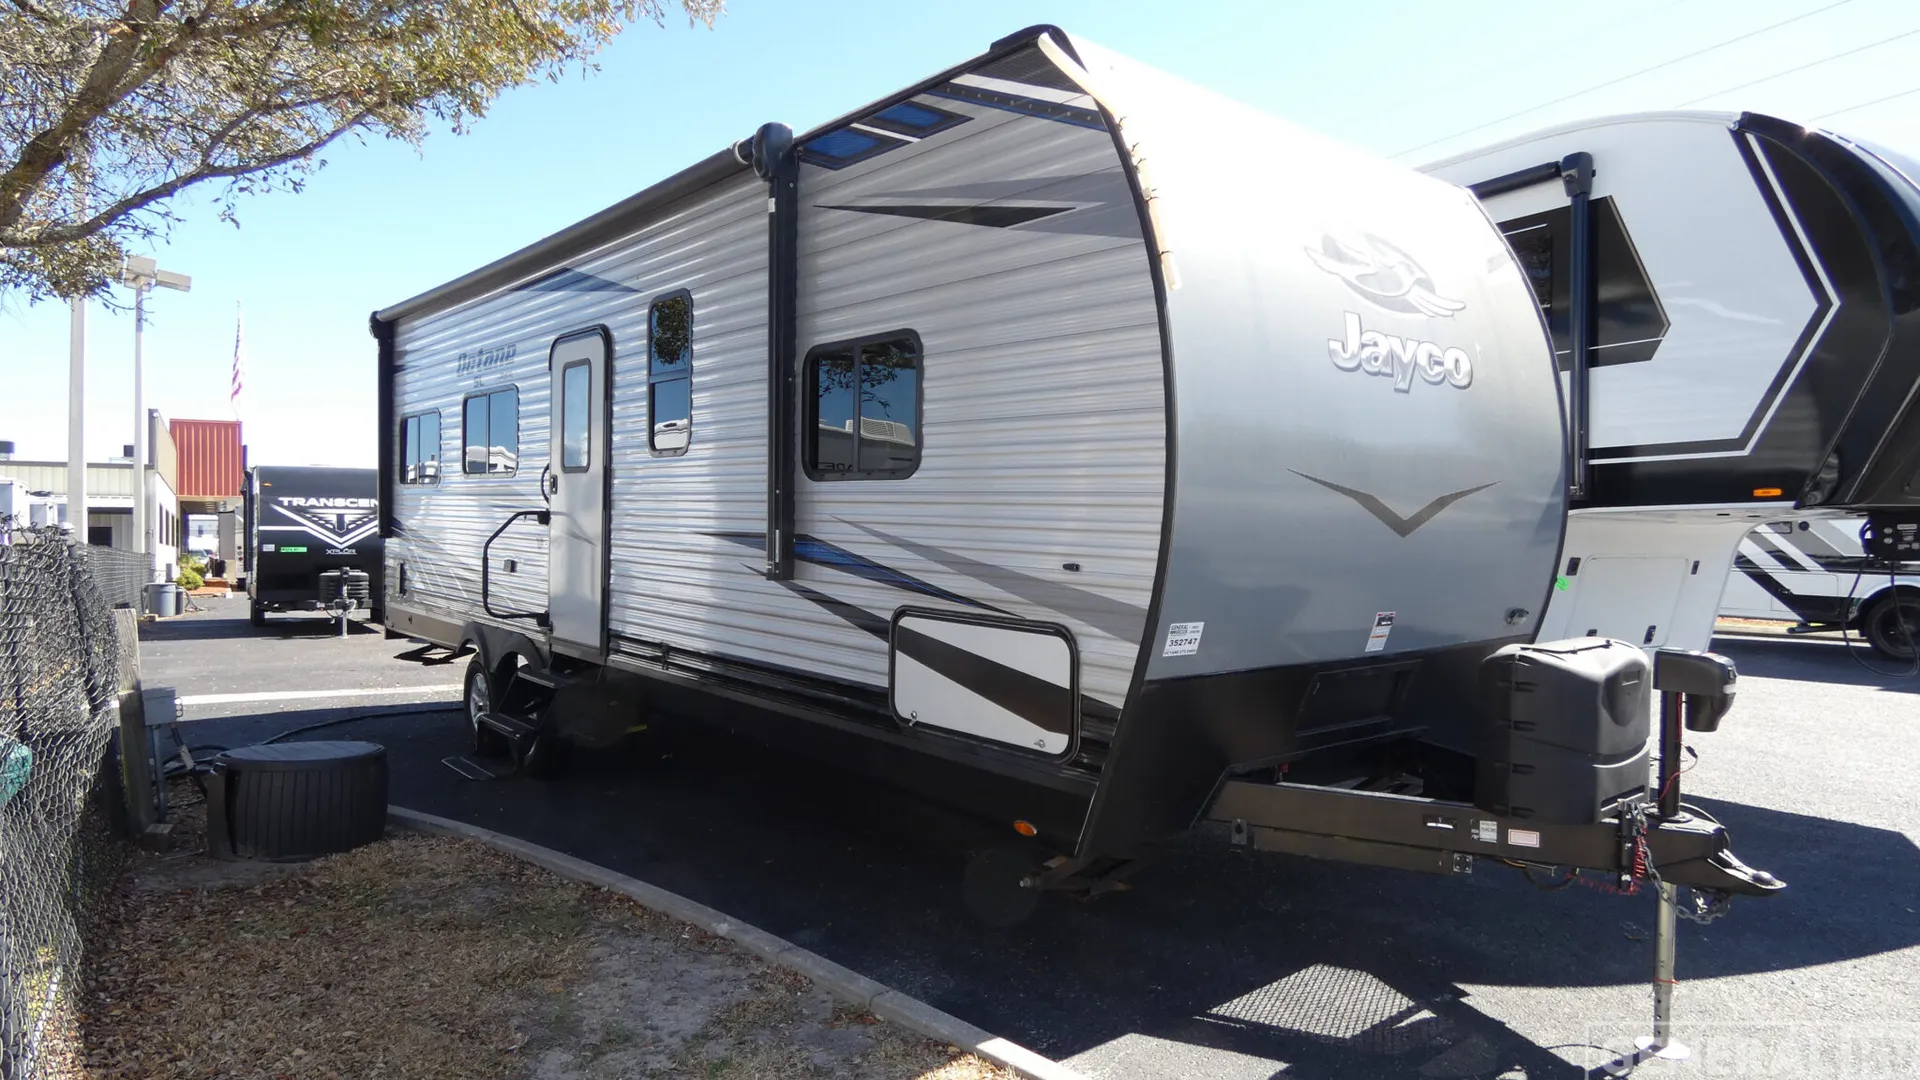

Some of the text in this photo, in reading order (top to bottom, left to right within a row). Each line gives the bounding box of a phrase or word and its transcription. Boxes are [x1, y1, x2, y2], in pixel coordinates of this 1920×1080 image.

[1327, 310, 1473, 394] Jayco
[278, 497, 379, 508] TRANSCEN
[1168, 638, 1197, 647] 352747
